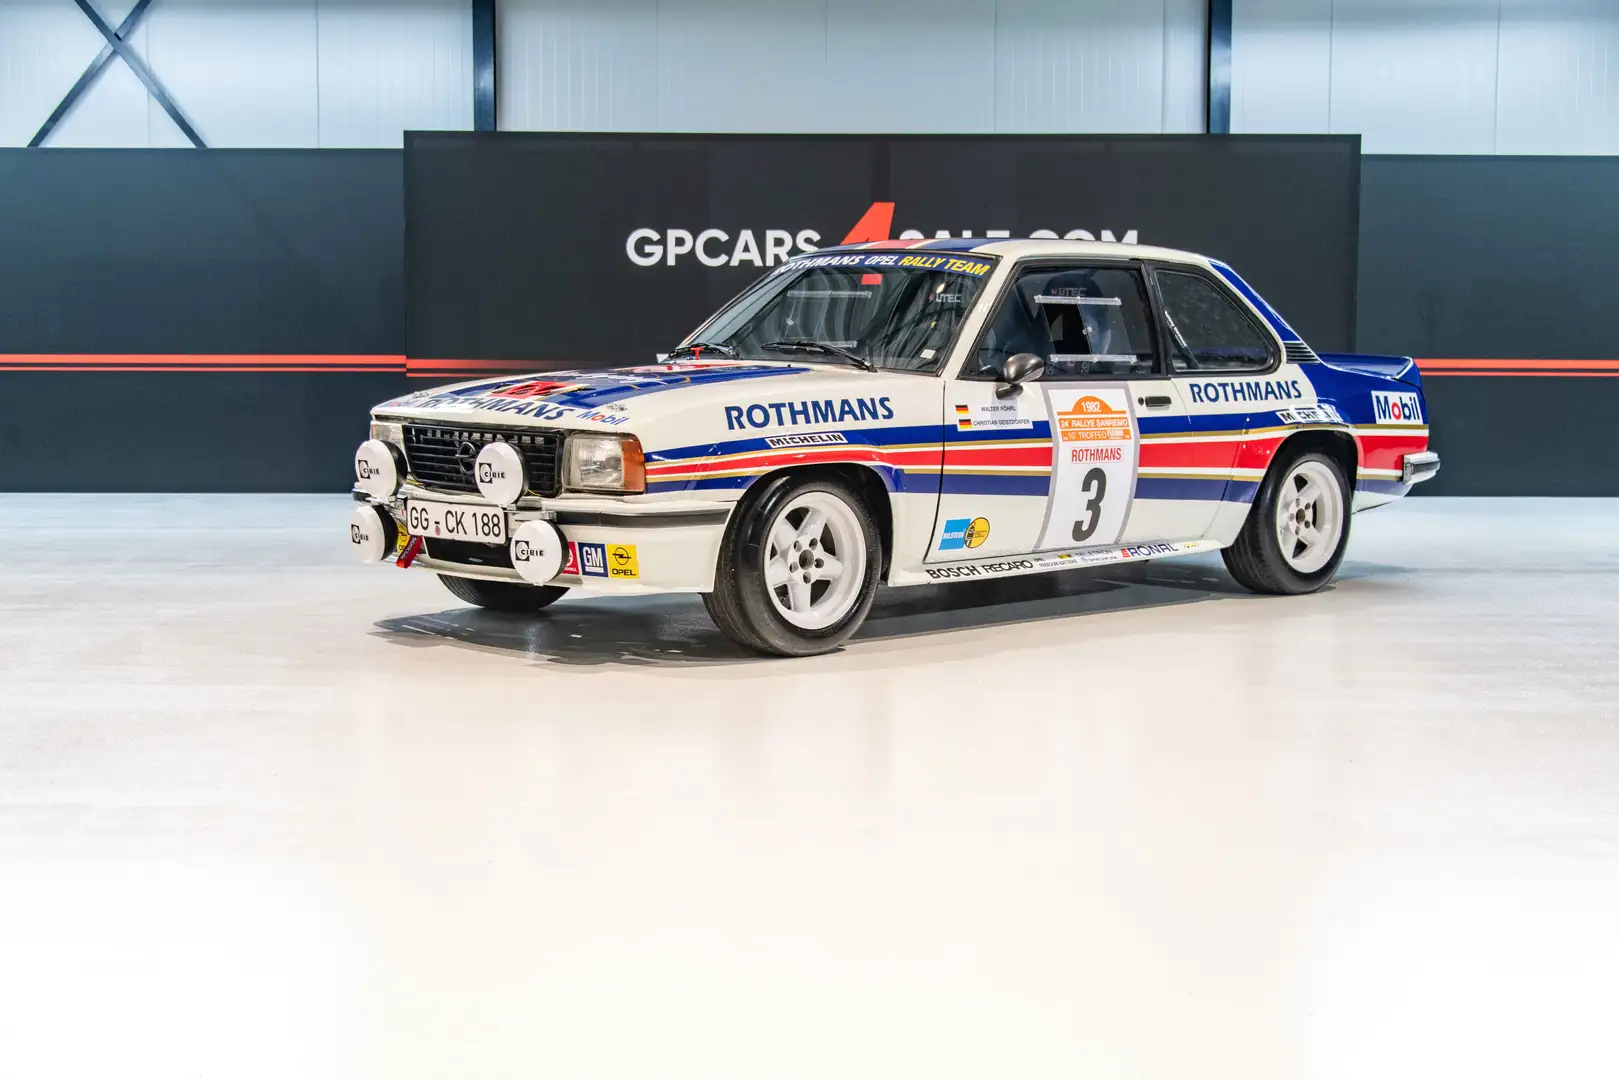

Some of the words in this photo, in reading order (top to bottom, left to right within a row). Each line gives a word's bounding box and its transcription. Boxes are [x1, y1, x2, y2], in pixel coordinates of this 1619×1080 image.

[865, 256, 898, 266] OPEL
[899, 256, 946, 268] RALLY
[943, 259, 990, 276] TEAM
[1189, 380, 1302, 403] ROTHMANS
[724, 396, 894, 430] ROTHMANS
[1000, 404, 1016, 412] RÖHRL
[1081, 401, 1102, 413] 1982
[1375, 394, 1420, 420] Mobil
[576, 410, 629, 426] Mobil
[973, 419, 998, 427] CHRISTIAN
[1071, 419, 1095, 428] RALLYE
[1096, 418, 1128, 428] SANREMO
[769, 434, 846, 447] MICHELIN
[1071, 447, 1122, 462] ROTHMANS
[484, 471, 506, 479] CIBIE
[1072, 467, 1107, 542] 3
[410, 506, 429, 531] GG
[445, 510, 467, 535] CK
[471, 512, 501, 538] 188
[520, 549, 544, 557] CIBIE
[582, 546, 604, 568] GM
[1127, 543, 1179, 557] RONAL
[611, 568, 636, 576] OPEL
[925, 565, 981, 579] BOSCH
[981, 560, 1034, 573] RECARO
